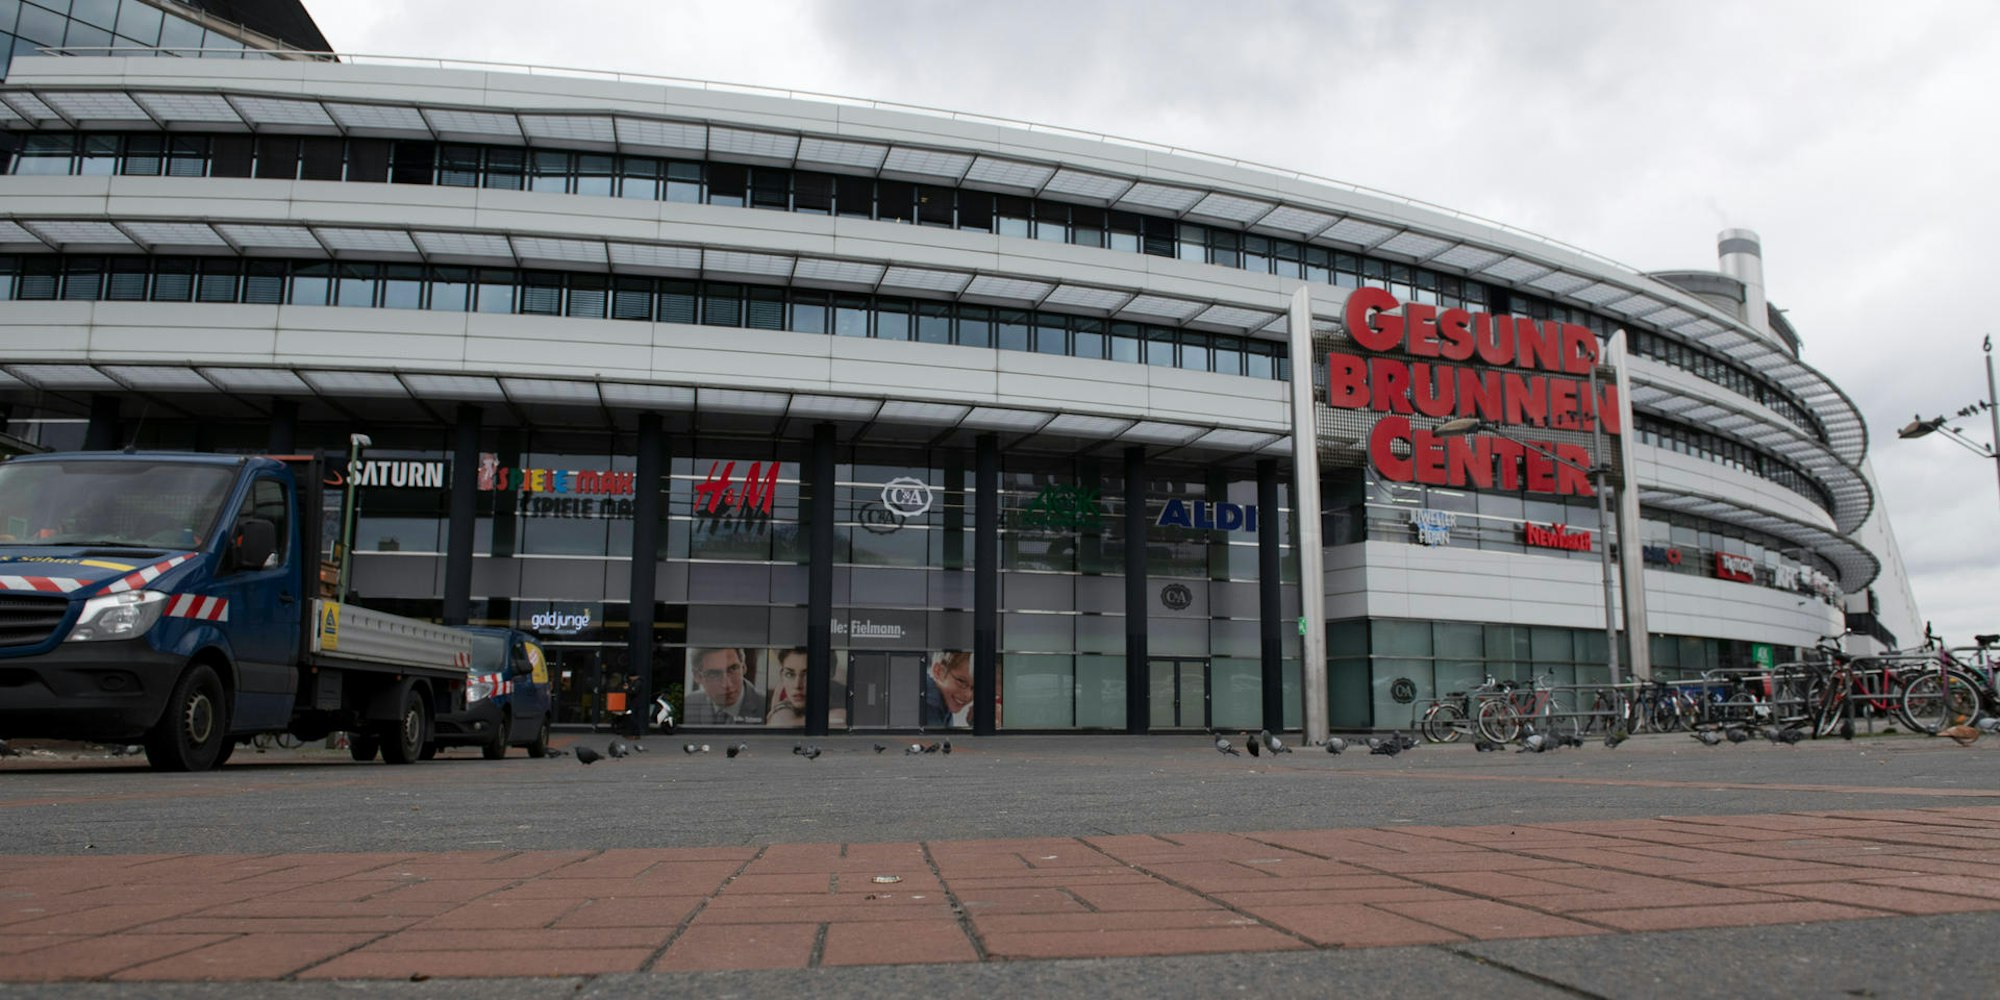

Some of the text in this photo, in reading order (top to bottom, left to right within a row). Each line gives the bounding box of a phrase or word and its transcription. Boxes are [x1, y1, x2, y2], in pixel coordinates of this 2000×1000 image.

[1343, 287, 1600, 374] GESUND
[1328, 353, 1621, 435] BRUNNEN
[1368, 416, 1595, 496] CENTER
[346, 460, 444, 488] SATURN
[496, 466, 634, 495] SPIELE MAX
[693, 460, 781, 516] H&M
[891, 488, 924, 505] C&A
[1155, 498, 1258, 532] ALDI
[850, 619, 906, 637] Fielmann.
